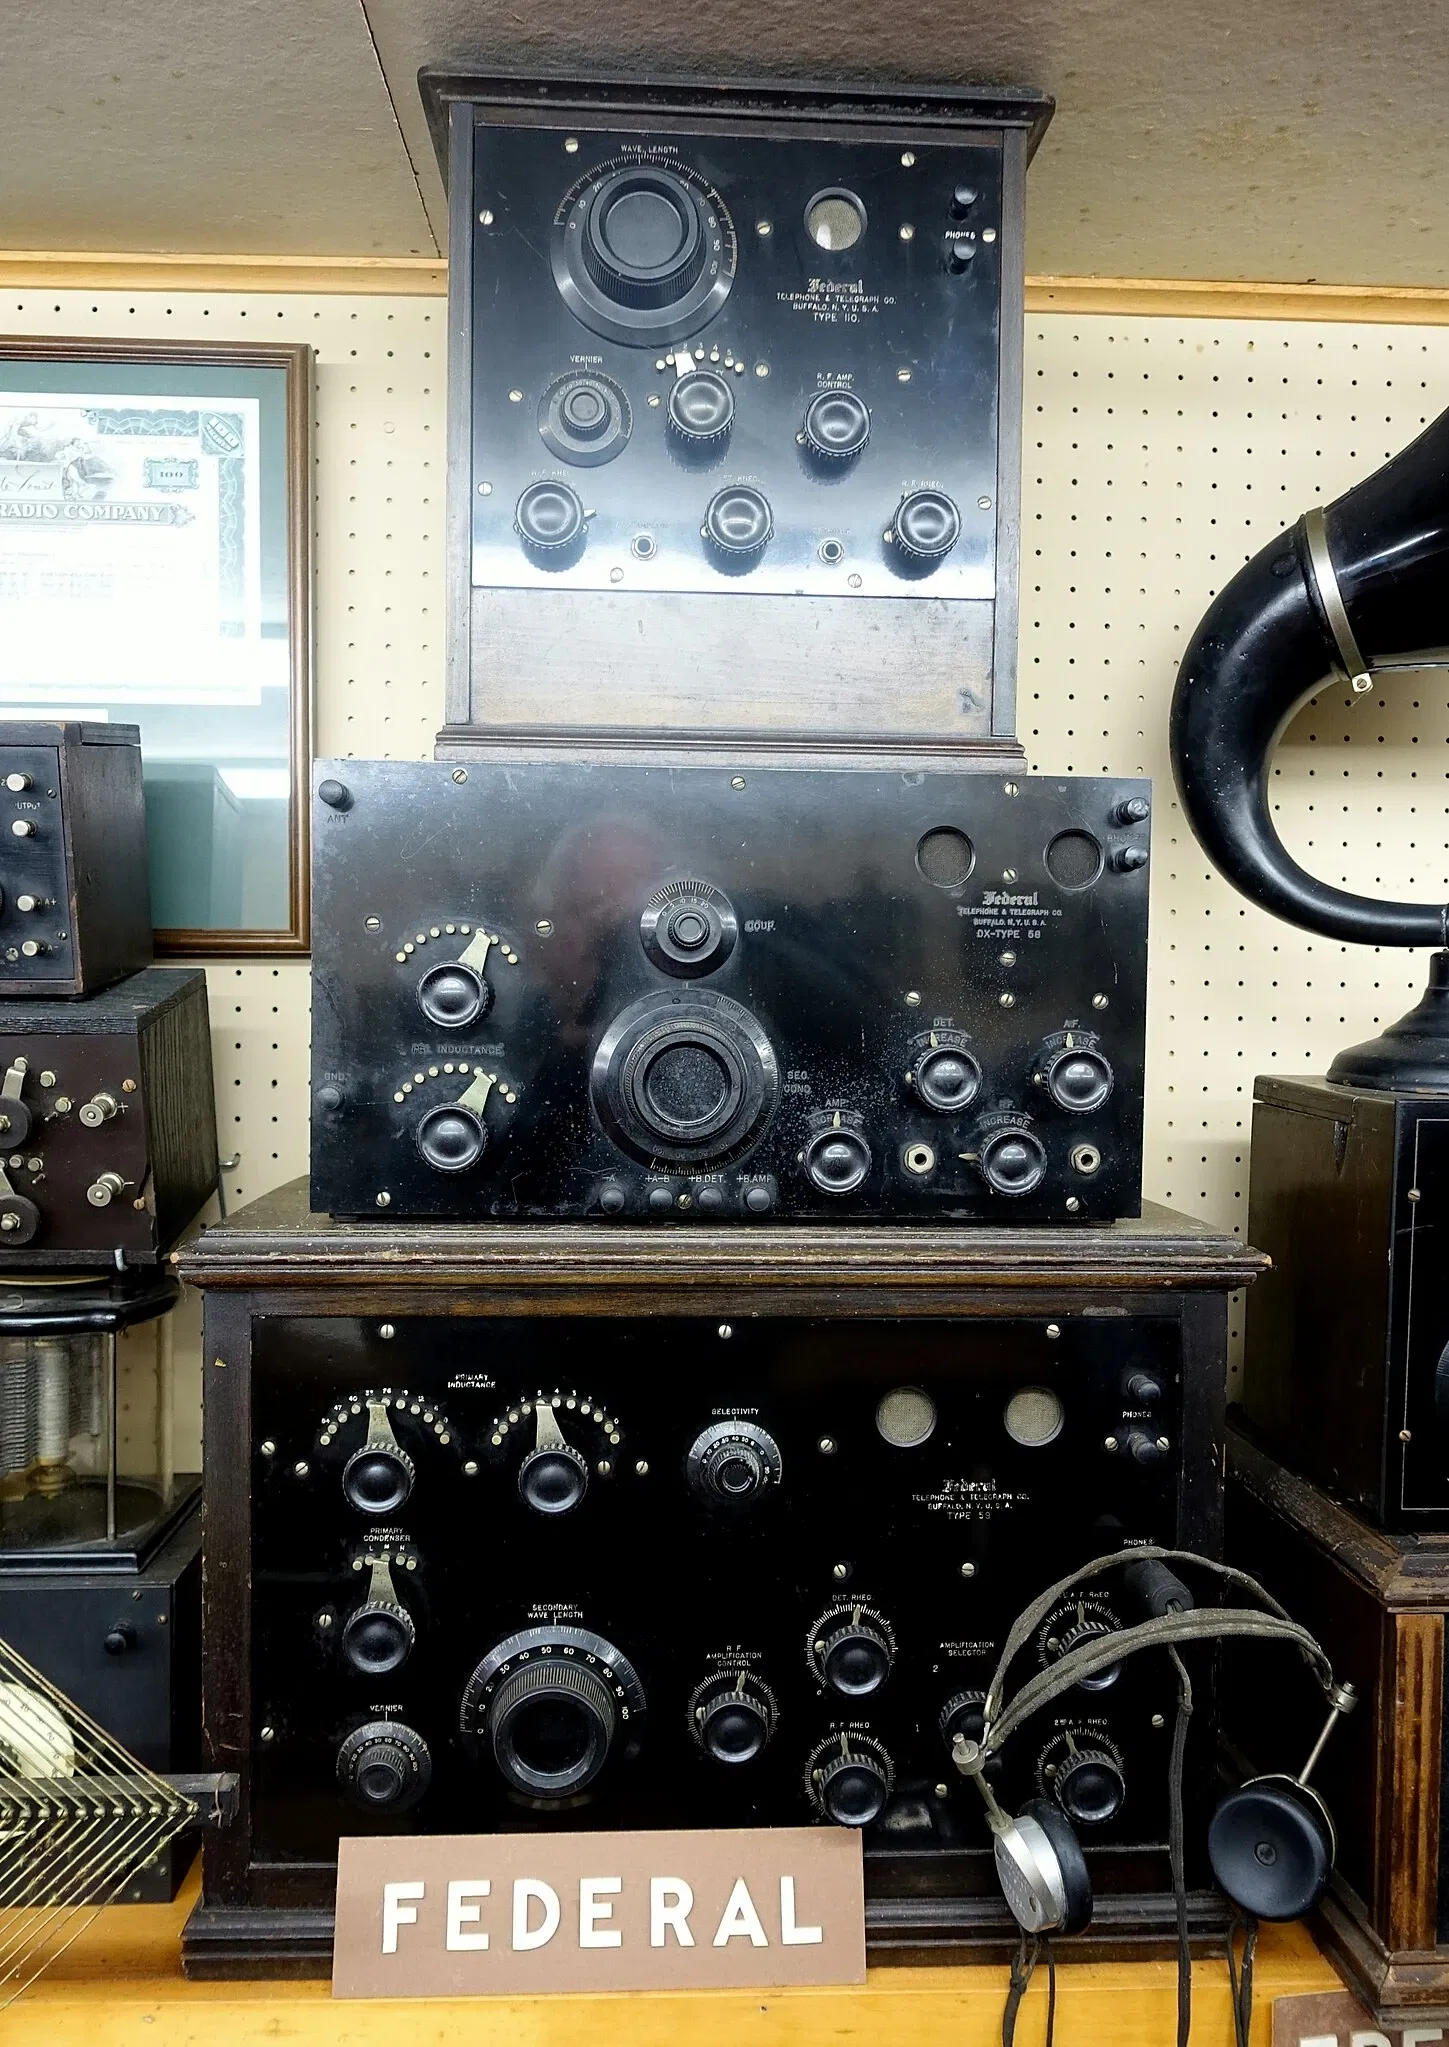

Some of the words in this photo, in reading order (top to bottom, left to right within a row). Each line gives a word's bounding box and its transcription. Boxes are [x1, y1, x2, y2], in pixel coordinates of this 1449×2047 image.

[621, 144, 642, 153] WAVE
[648, 146, 679, 154] LENGTH
[776, 292, 821, 301] TELEPHONE
[835, 294, 880, 303] TELEGRAPH
[814, 312, 838, 322] TYPE
[569, 355, 603, 364] VERNIER
[817, 380, 852, 388] CONTROL
[159, 470, 184, 479] 100
[63, 504, 165, 521] COMPANY
[982, 890, 1039, 906] Federal
[958, 906, 999, 916] TELEPHONE
[1010, 907, 1049, 916] TELEGRAPH
[976, 929, 1020, 940] DX-TYPE
[1044, 1034, 1097, 1050] INCASE
[437, 1044, 502, 1056] INDUCTANCE
[808, 1113, 863, 1128] INCRASE
[455, 1373, 488, 1381] PRIMARY
[447, 1381, 496, 1389] INDUCTANCE
[711, 1407, 760, 1416] SELECTIVITY
[911, 1493, 955, 1501] TELEPHONE
[970, 1493, 1013, 1501] TELEGRAPH
[947, 1511, 972, 1520] TYPE
[370, 1527, 404, 1535] PRIMARY
[363, 1534, 411, 1542] CONDENSER
[532, 1603, 579, 1611] SECONDARY
[527, 1611, 549, 1619] WAVE
[553, 1611, 584, 1619] LENGTH
[939, 1641, 995, 1649] AMPLIFICATION
[706, 1652, 763, 1660] AMPLIFICATION
[948, 1649, 987, 1657] SELECTOR
[716, 1659, 752, 1667] CONTROL
[932, 1664, 939, 1674] 2
[499, 1663, 510, 1675] 30
[518, 1652, 530, 1661] 40
[541, 1646, 552, 1655] 50
[563, 1647, 575, 1655] 60
[585, 1654, 596, 1664] 70
[602, 1667, 613, 1679] 80
[615, 1685, 625, 1698] 90
[621, 1706, 630, 1721] 100
[369, 1704, 404, 1712] VERNIER
[382, 1874, 823, 1954] FEDERAL
